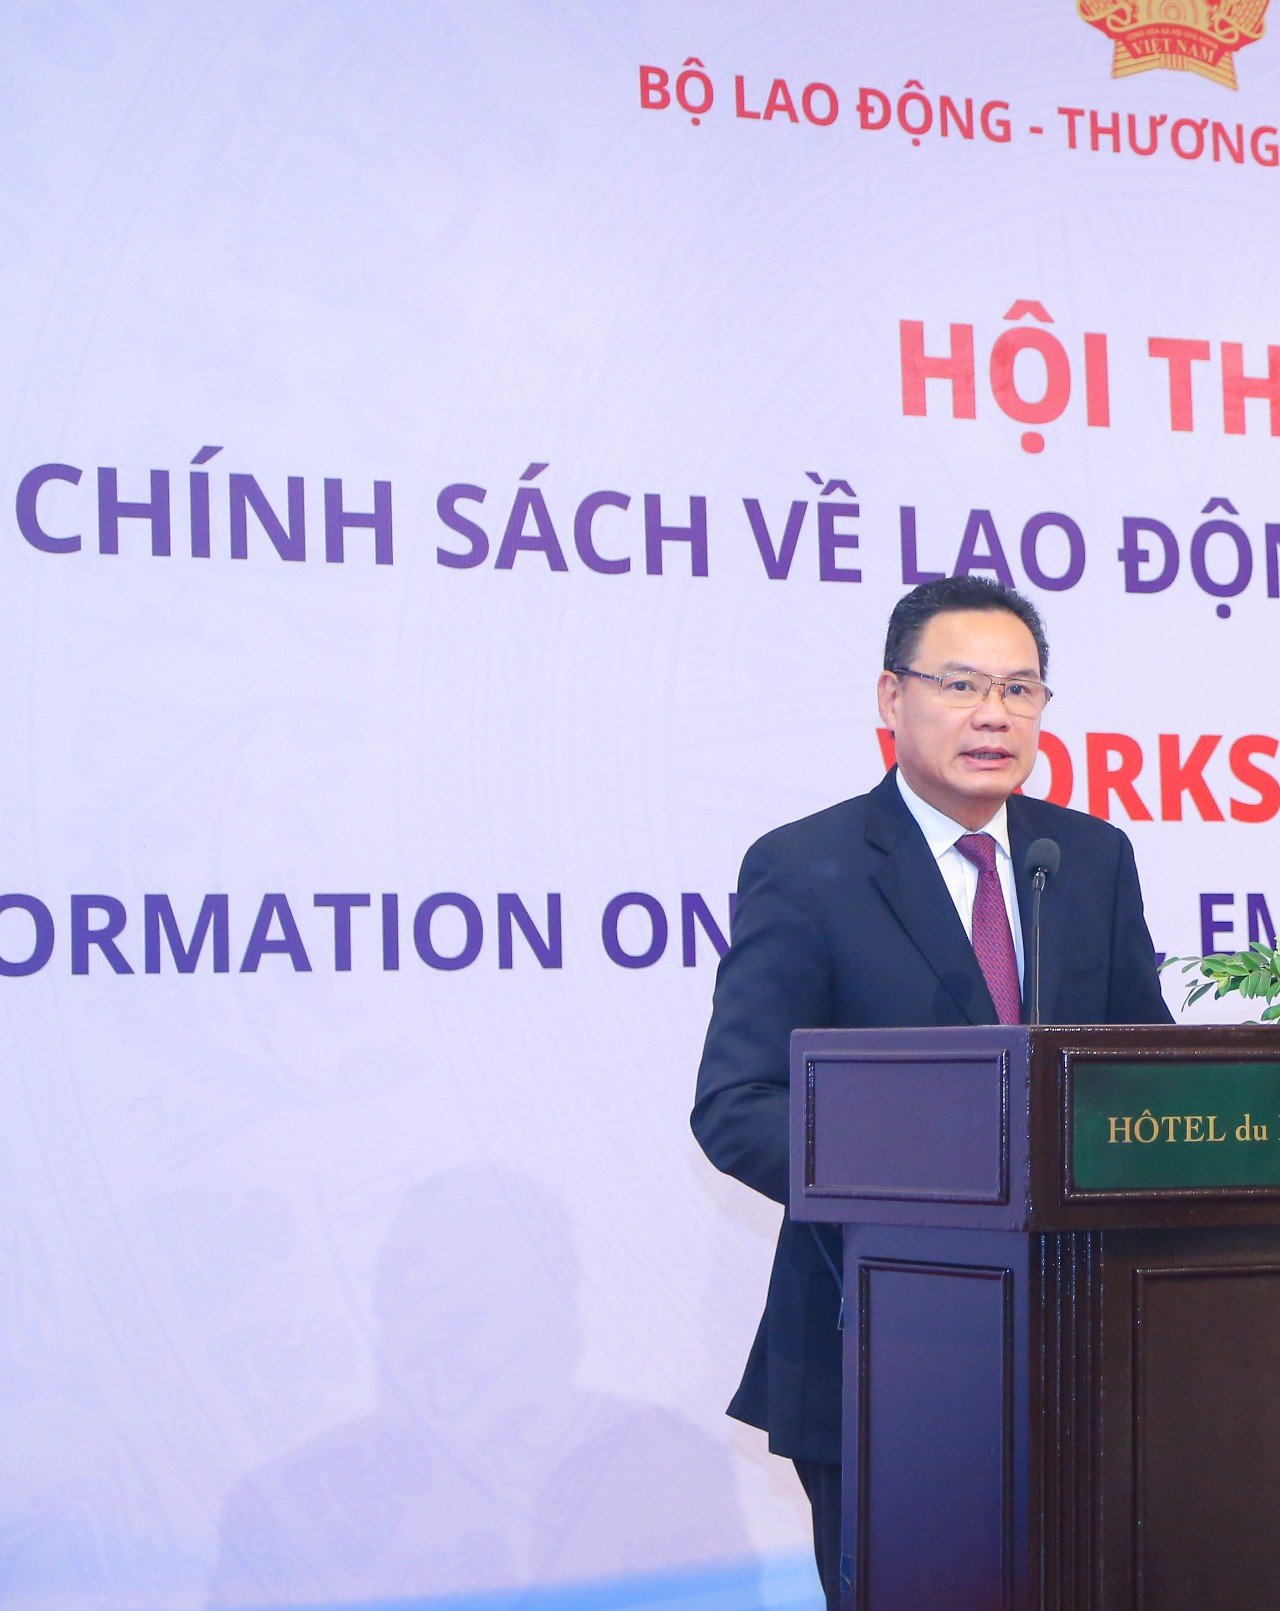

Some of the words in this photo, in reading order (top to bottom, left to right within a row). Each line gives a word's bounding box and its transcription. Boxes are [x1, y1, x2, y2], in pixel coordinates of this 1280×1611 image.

[638, 57, 714, 126] BỘ
[734, 75, 839, 127] LAO
[855, 79, 1011, 147] ĐỘNG
[1057, 107, 1280, 168] THƯƠNG
[898, 299, 1110, 454] HỘI
[16, 445, 394, 566] CHÍNH
[437, 462, 709, 579] SÁCH
[742, 471, 863, 584] VỀ
[899, 505, 1087, 593] LAO
[600, 891, 737, 970] ON
[1107, 1109, 1227, 1144] HÔTEL
[1235, 1113, 1269, 1142] du
